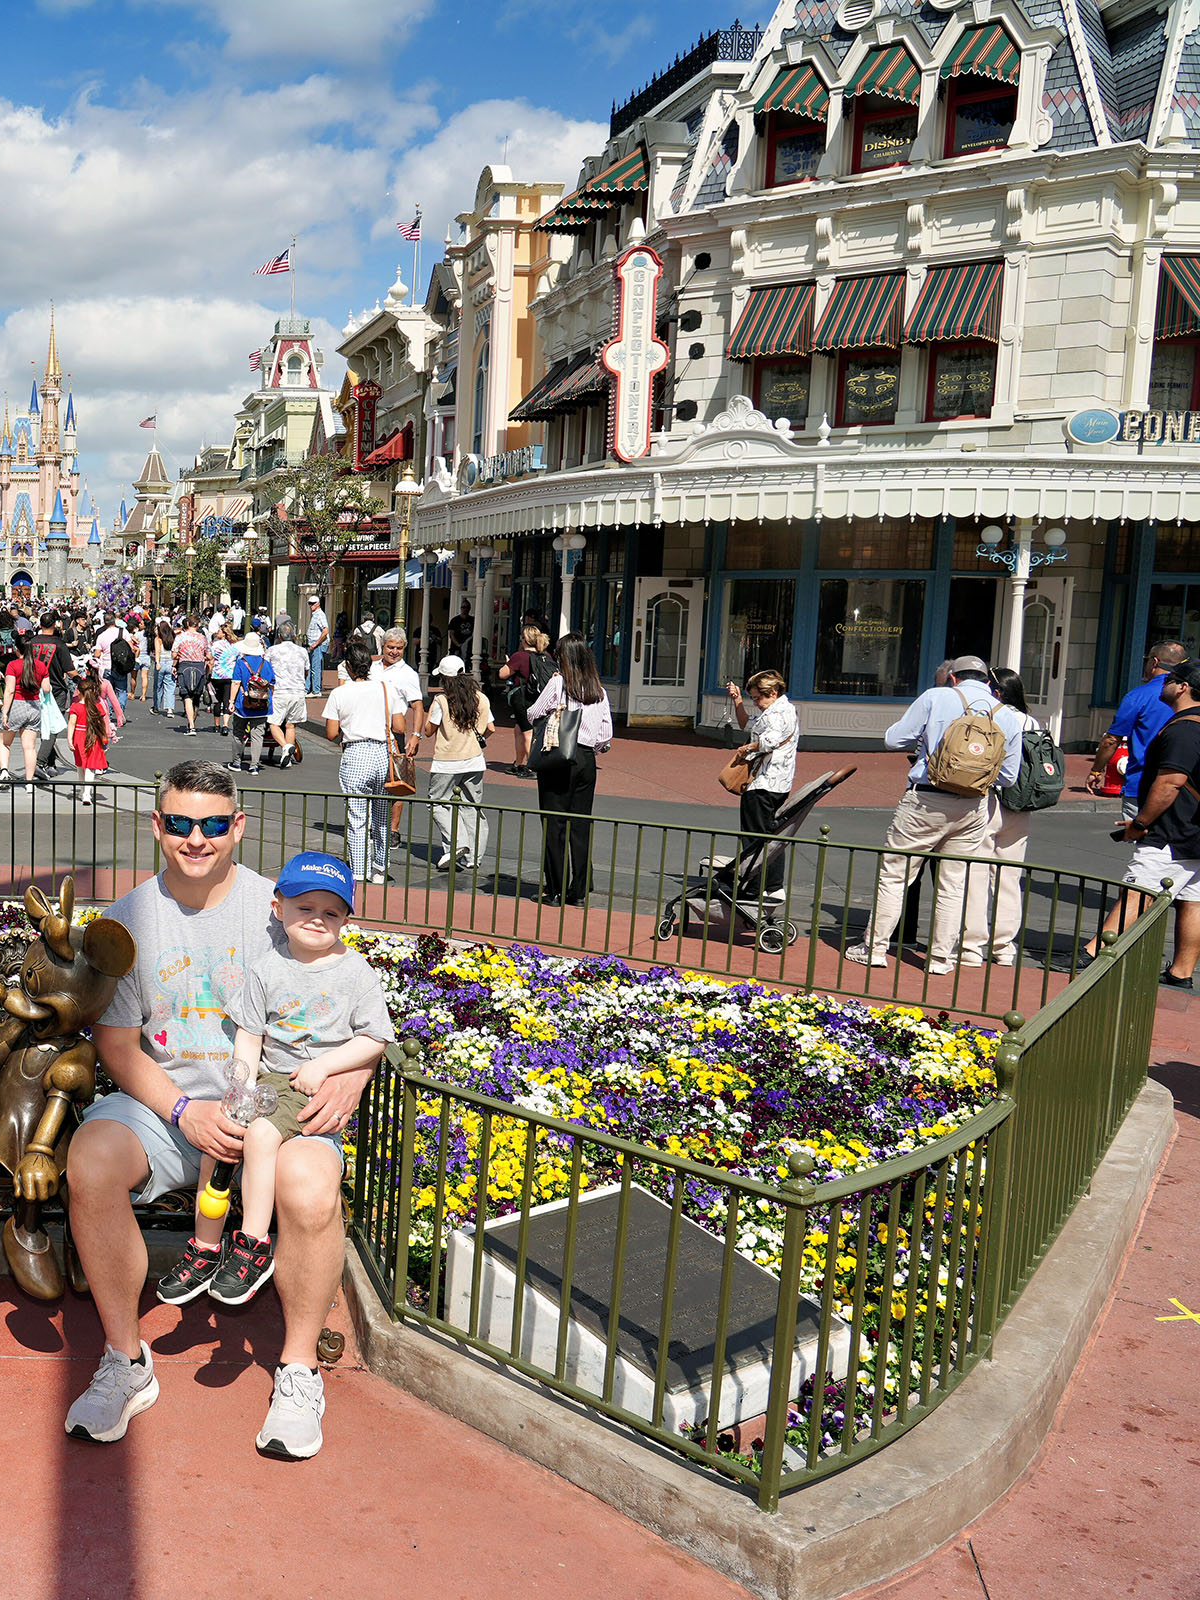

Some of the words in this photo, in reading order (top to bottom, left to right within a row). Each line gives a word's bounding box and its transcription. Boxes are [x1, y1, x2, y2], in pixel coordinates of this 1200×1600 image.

[627, 270, 645, 448] CONFECTIONERY
[835, 623, 904, 634] CONFECTIONERY
[207, 1052, 230, 1061] TRIP
